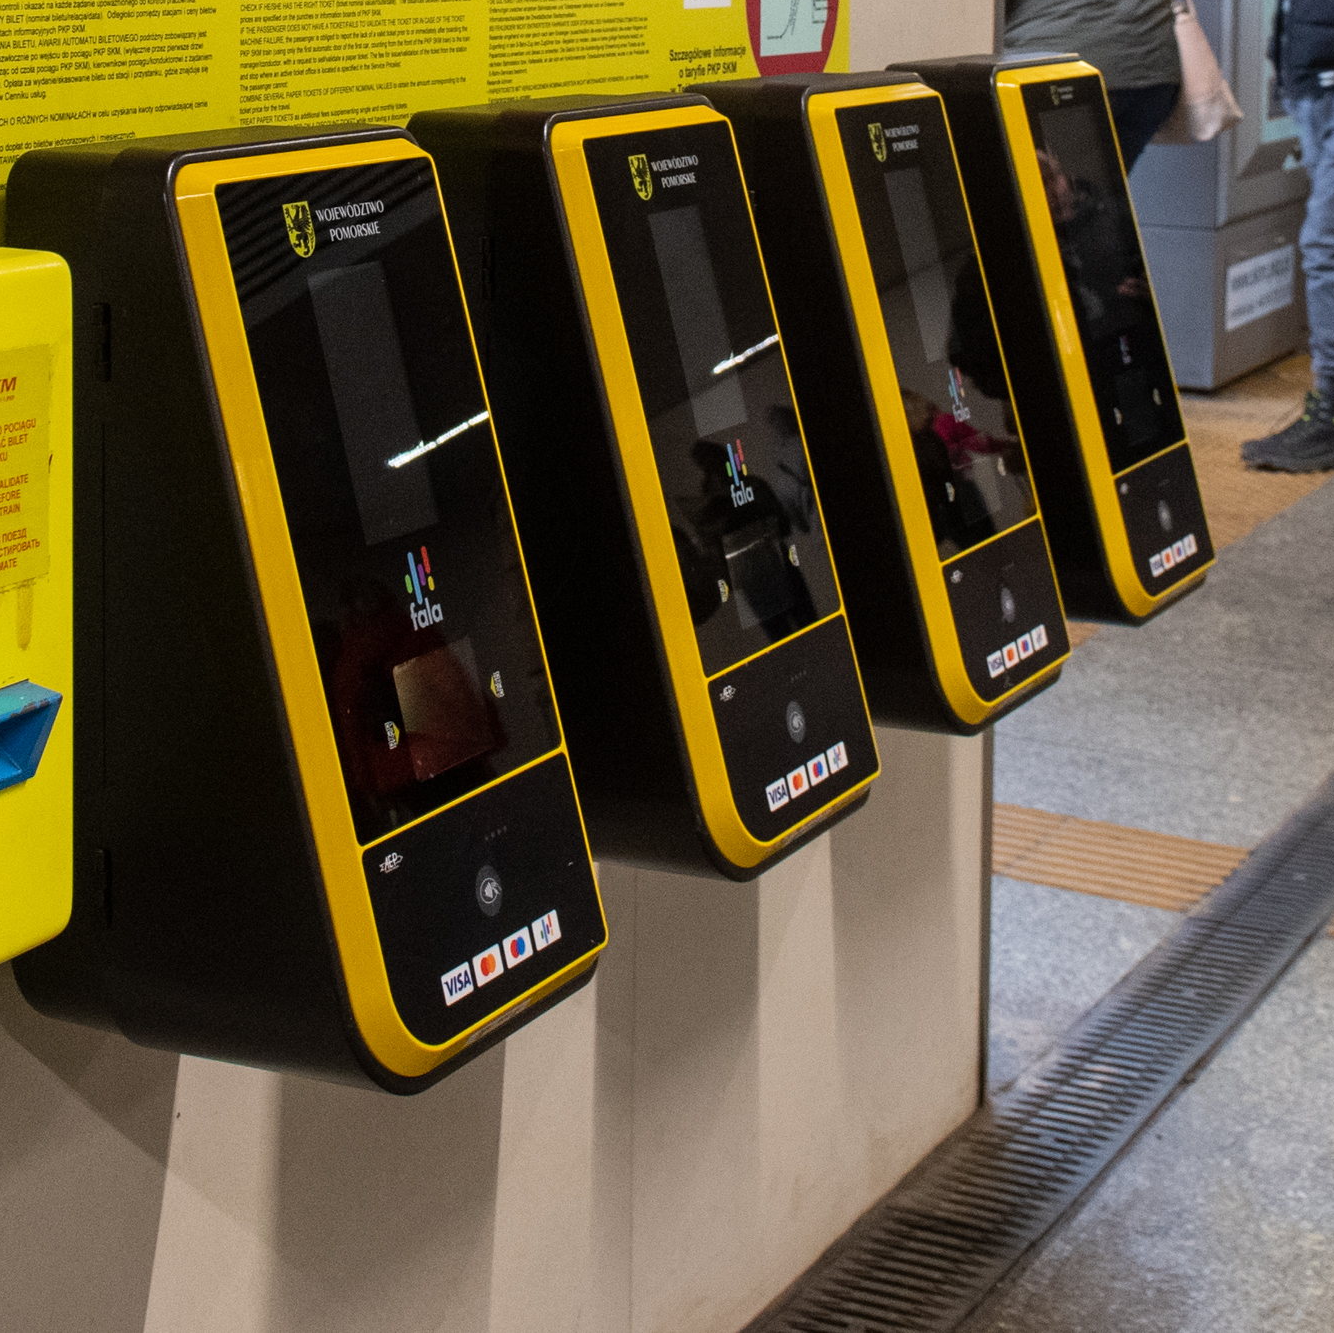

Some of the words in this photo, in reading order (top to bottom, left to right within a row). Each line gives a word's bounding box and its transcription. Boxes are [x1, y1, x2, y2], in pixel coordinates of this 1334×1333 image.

[669, 49, 711, 63] Szczegółowe
[713, 45, 746, 62] informacje
[650, 155, 697, 171] WOJEWÓDZTWO
[661, 172, 695, 187] POMORSKIE
[315, 200, 383, 221] WOJEWÓDZTWO
[329, 220, 380, 241] POMORSKIE
[730, 481, 754, 507] fala
[409, 597, 443, 630] fala
[768, 784, 788, 806] VISA
[444, 970, 471, 996] VISA
